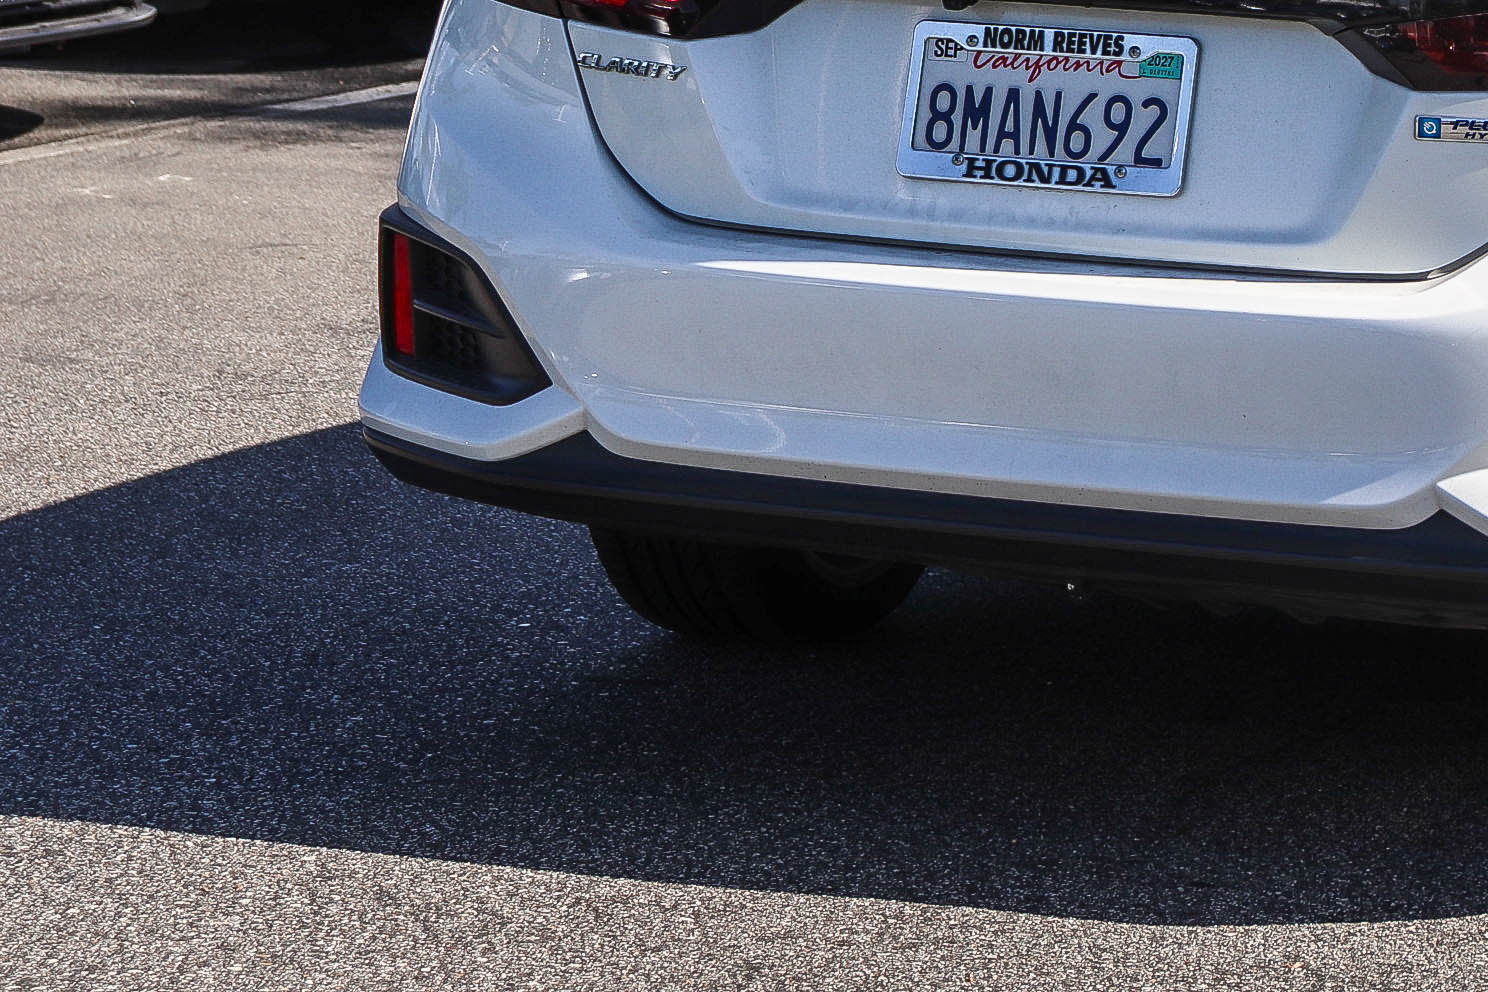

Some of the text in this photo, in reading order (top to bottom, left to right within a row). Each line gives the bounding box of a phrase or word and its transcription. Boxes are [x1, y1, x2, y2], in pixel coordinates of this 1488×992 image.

[934, 39, 964, 59] SEP
[983, 26, 1125, 57] NORM REEVES
[577, 51, 688, 82] CLARITY
[972, 50, 1142, 84] California
[1147, 54, 1174, 68] 2027
[924, 82, 1170, 167] 8MAN692
[961, 157, 1117, 189] HONDA
